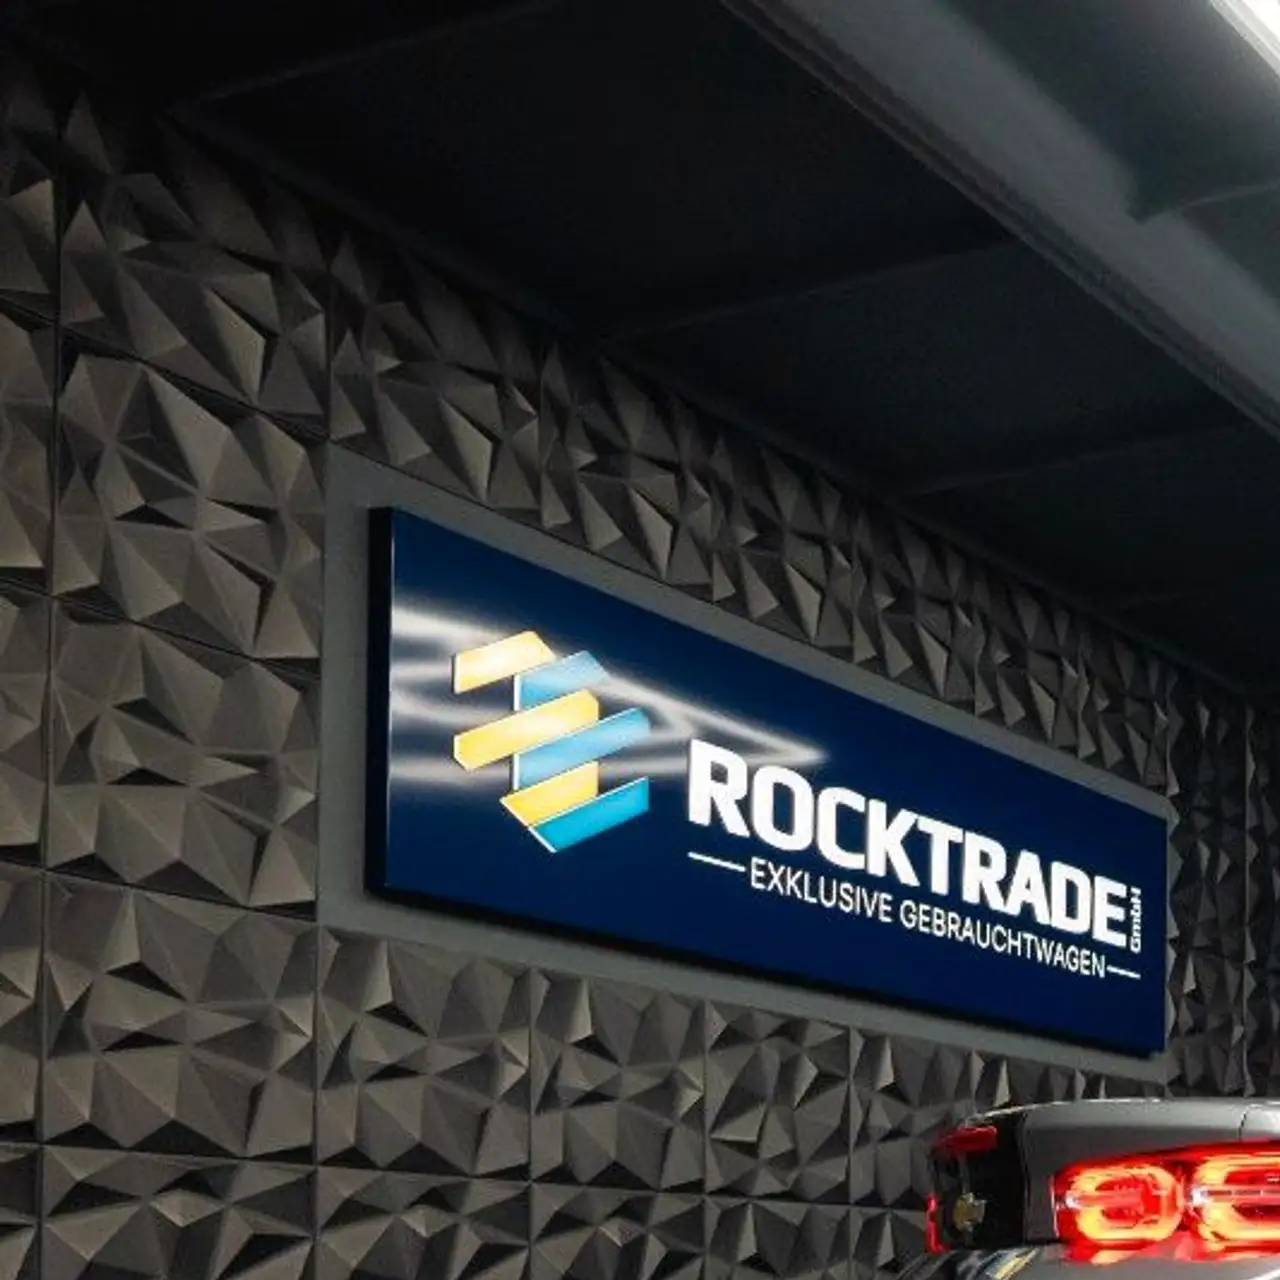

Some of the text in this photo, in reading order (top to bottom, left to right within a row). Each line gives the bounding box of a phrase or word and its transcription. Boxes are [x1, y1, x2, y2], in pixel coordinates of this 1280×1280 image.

[687, 738, 1127, 948] ROCKTRADE
[750, 857, 1105, 979] EXKLUSIVE GEBRAUCHTWAGEN
[1129, 886, 1142, 954] GmbH
